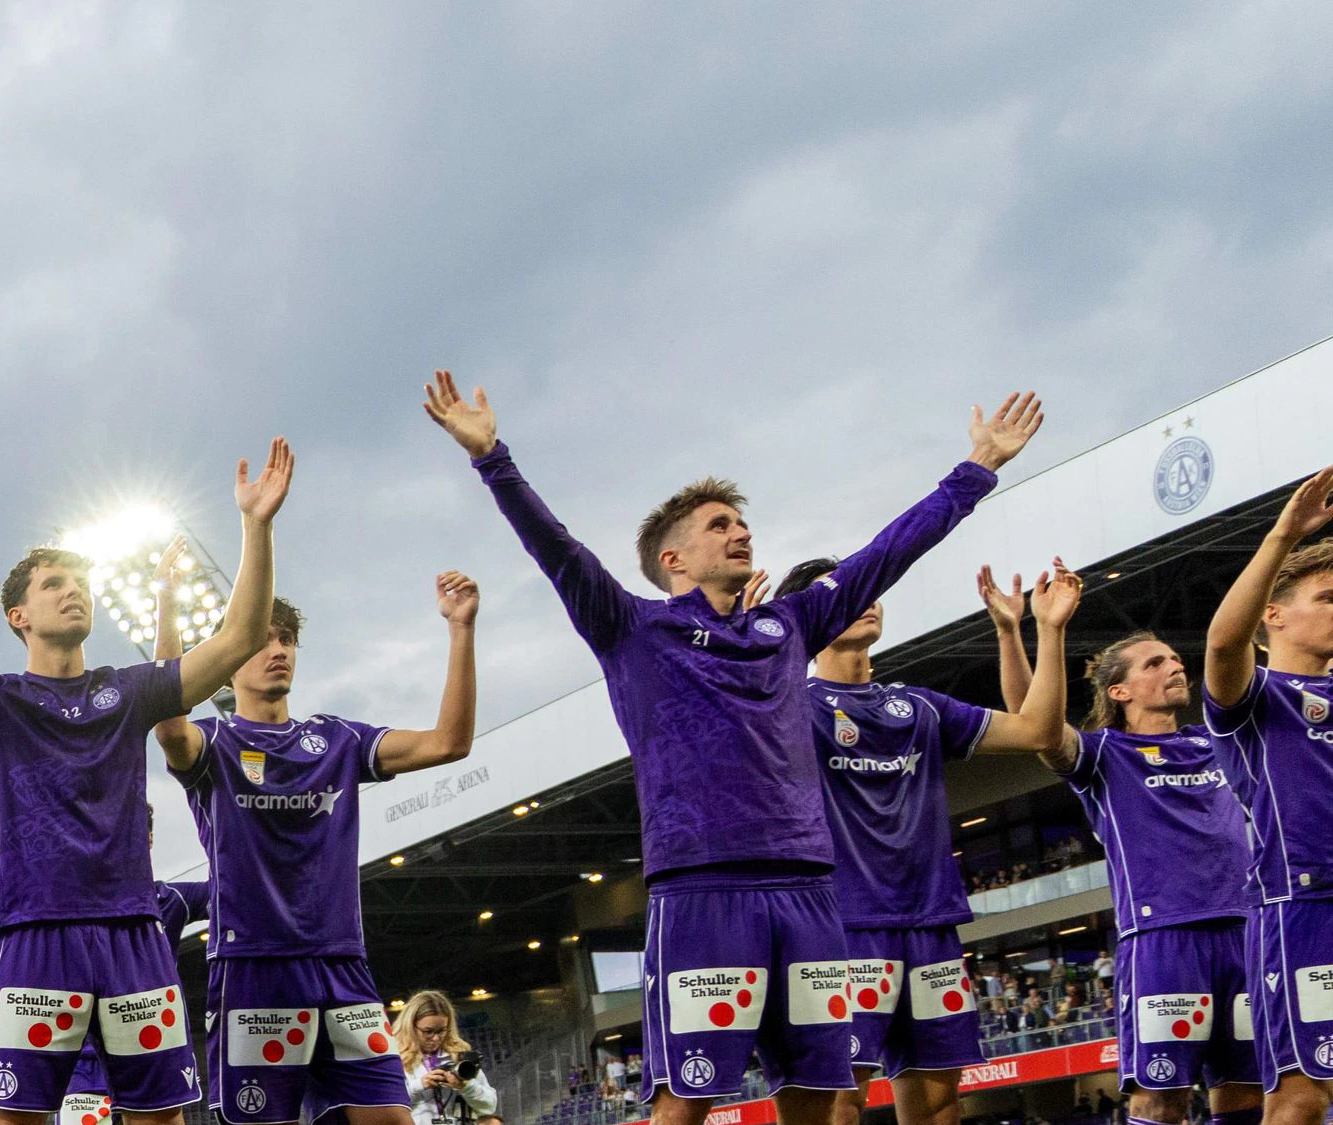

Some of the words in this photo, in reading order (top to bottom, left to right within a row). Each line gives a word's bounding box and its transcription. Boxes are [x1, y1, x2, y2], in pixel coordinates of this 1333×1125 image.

[692, 629, 710, 647] 21
[62, 706, 82, 719] 22
[1145, 769, 1219, 788] aramark
[236, 790, 318, 810] aramark
[385, 791, 429, 823] GENERALI
[456, 766, 491, 794] ARENA
[800, 967, 846, 980] Schuller
[848, 964, 882, 976] huller
[679, 973, 741, 988] Schuller
[691, 987, 733, 998] Eh'klar
[6, 993, 64, 1007] Schuller
[108, 997, 162, 1015] Schuller
[1147, 998, 1197, 1009] Schuller
[15, 1006, 54, 1018] Eh'klar
[121, 1011, 157, 1024] Eh'klar
[335, 1009, 382, 1024] Schuller
[238, 1014, 292, 1025] Schuller
[248, 1026, 283, 1035] Eh'klar
[64, 1095, 101, 1105] Schuller
